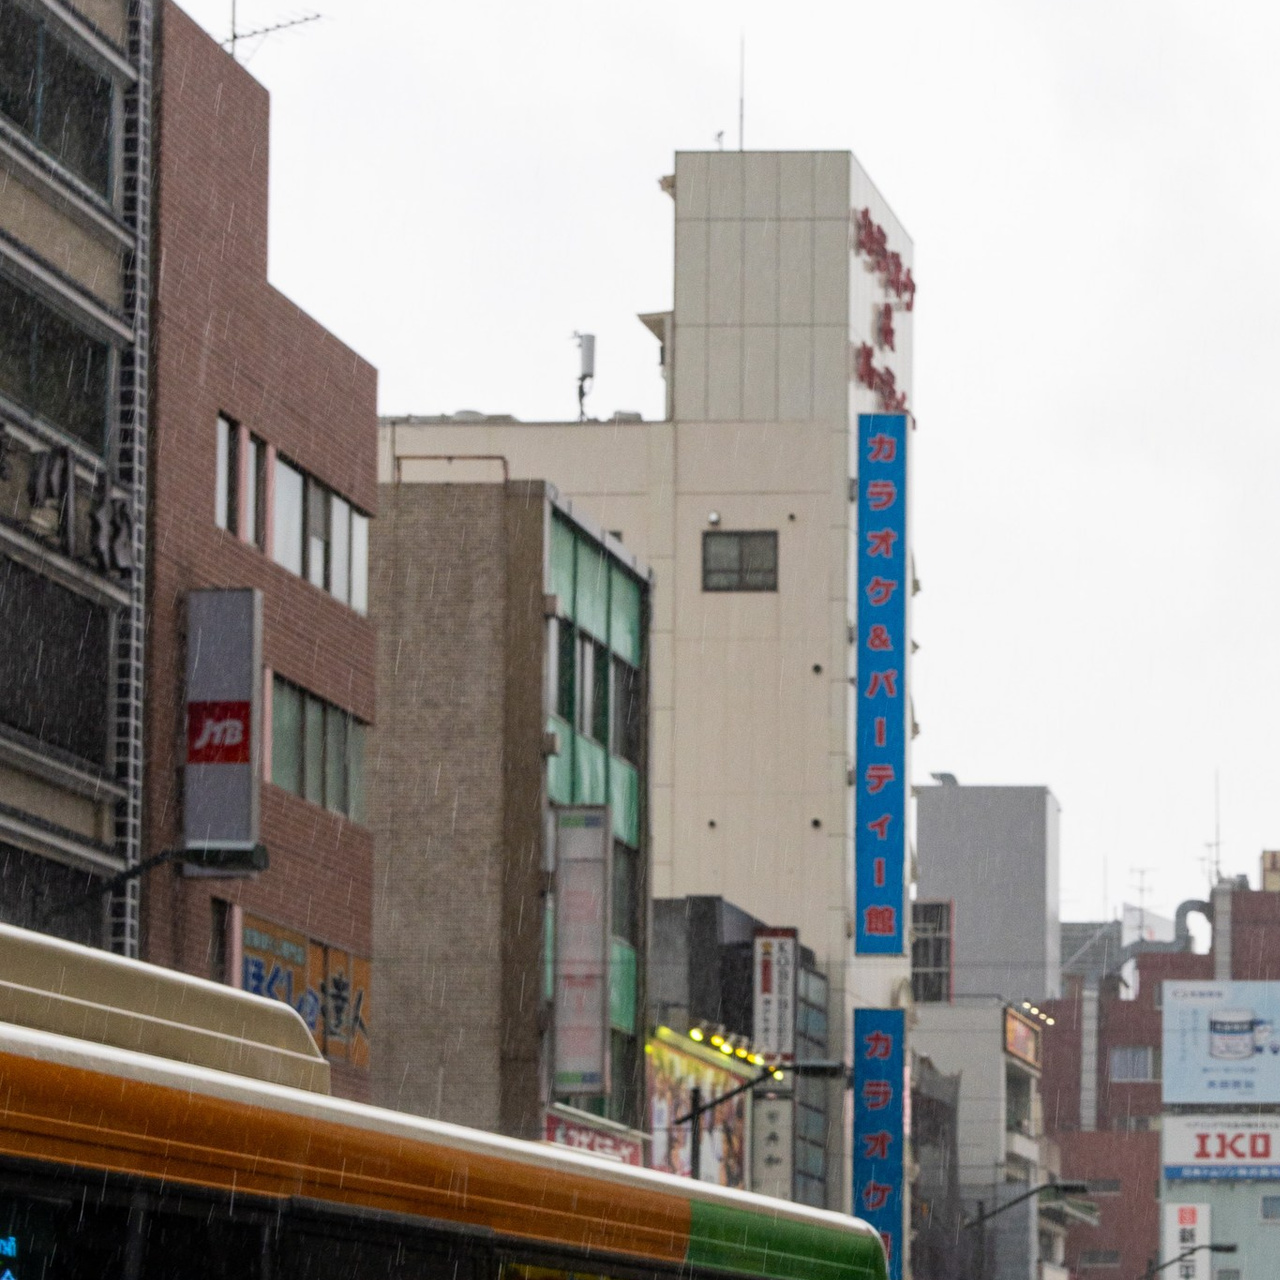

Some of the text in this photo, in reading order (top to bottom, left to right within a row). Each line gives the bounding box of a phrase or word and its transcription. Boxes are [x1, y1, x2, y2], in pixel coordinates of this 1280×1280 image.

[193, 719, 243, 750] JTB
[862, 1029, 893, 1260] カラオケ
